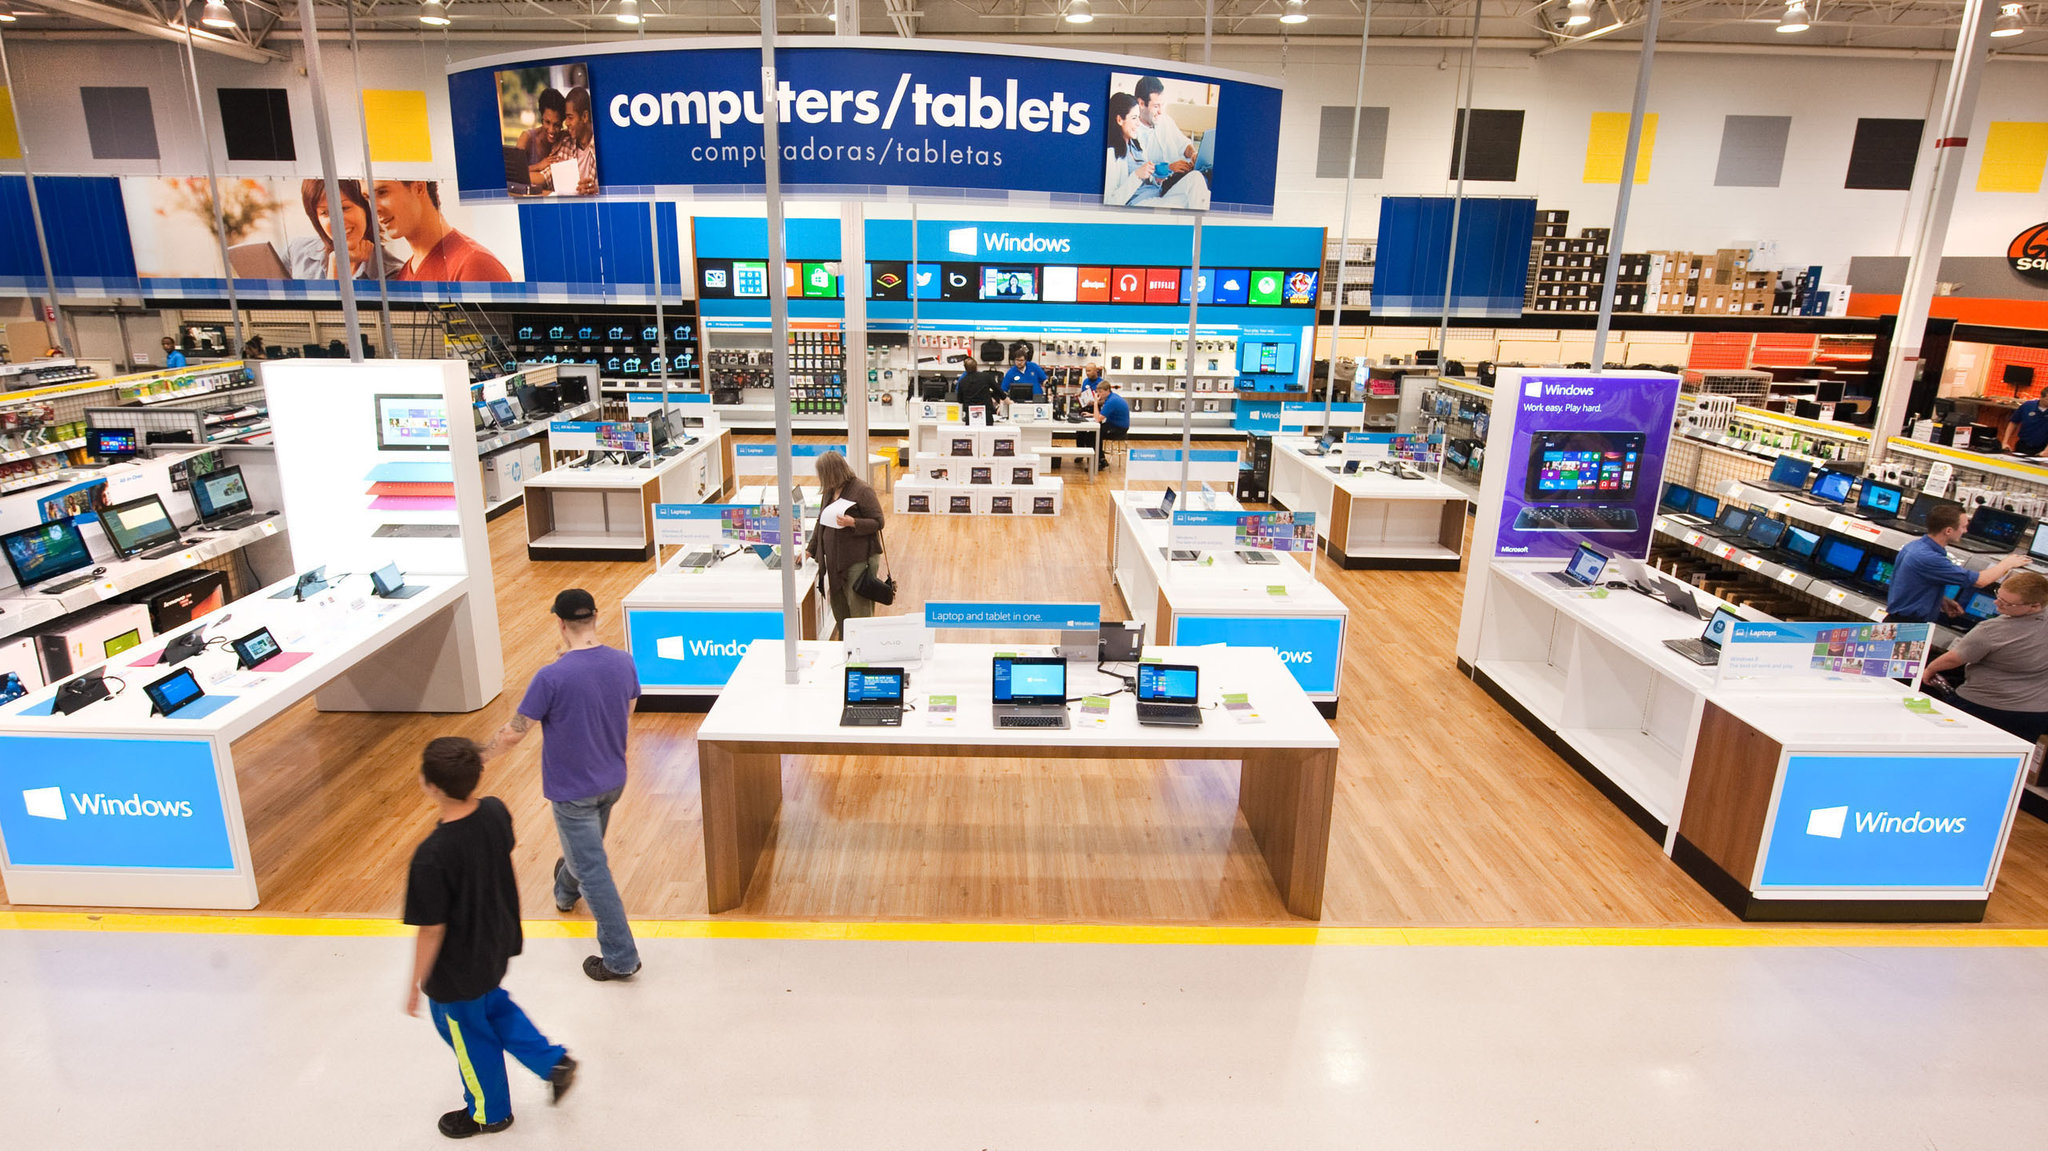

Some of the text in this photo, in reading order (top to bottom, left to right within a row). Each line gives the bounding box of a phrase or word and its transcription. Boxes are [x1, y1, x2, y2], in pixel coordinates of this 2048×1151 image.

[691, 137, 1002, 168] compuadoras/tabletas
[983, 232, 1071, 253] Windows
[1545, 384, 1594, 396] Windows
[1523, 403, 1602, 414] Work easy. Play hard.
[932, 611, 1043, 624] Laptop and tablet in one.
[1749, 629, 1777, 638] Laptops
[689, 639, 749, 657] Windo
[70, 793, 193, 817] Windows
[1855, 811, 1967, 833] Windows
